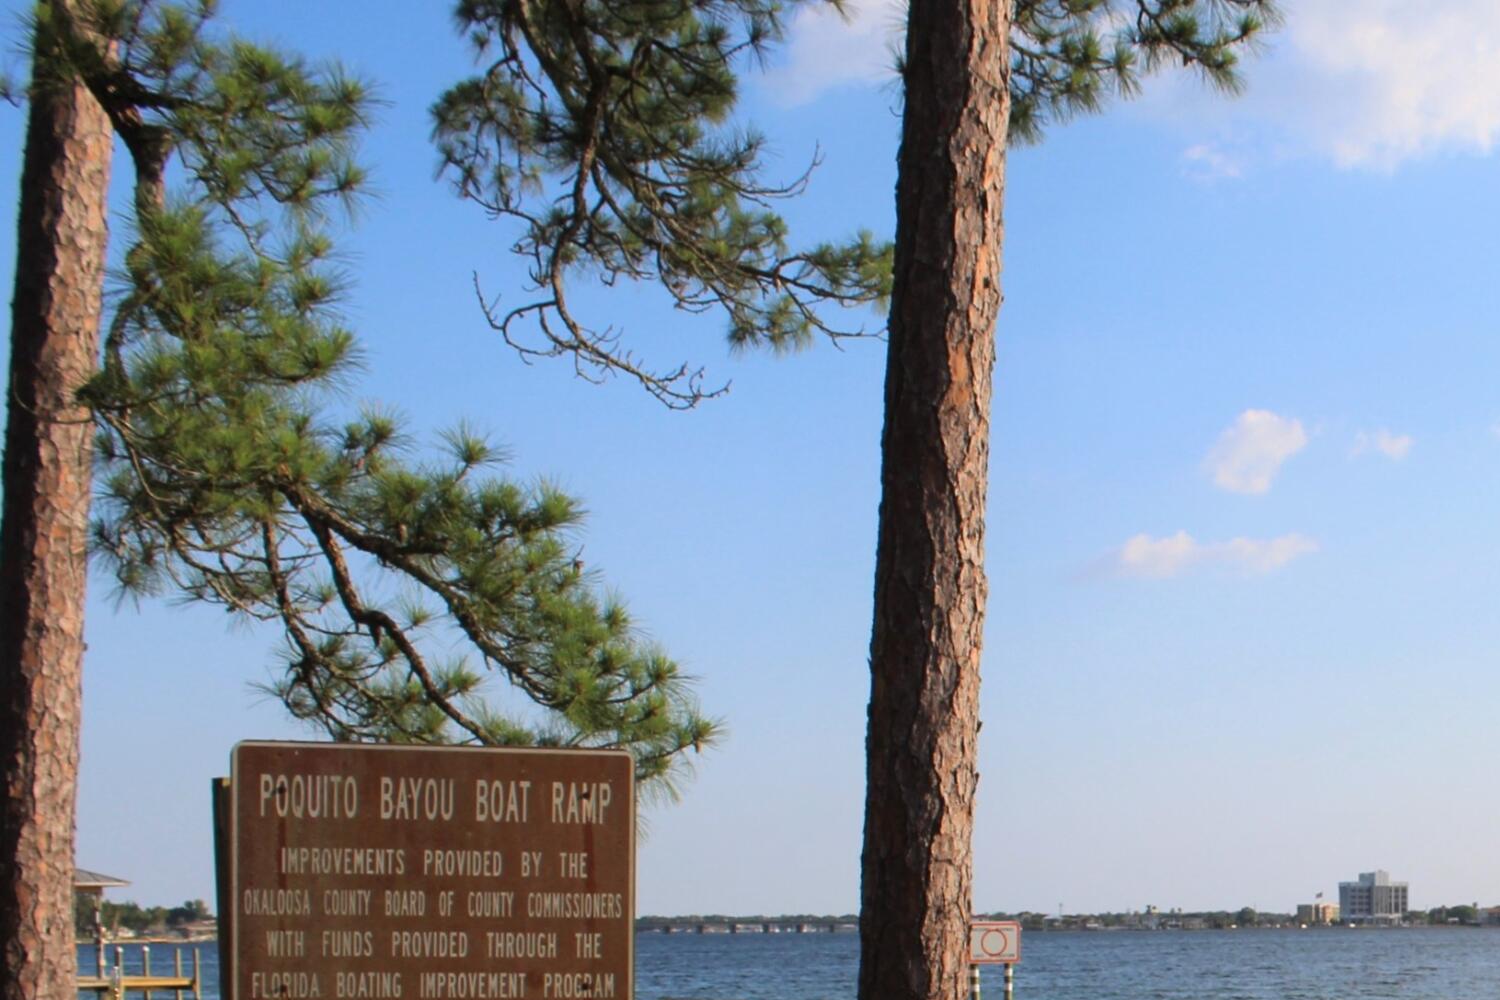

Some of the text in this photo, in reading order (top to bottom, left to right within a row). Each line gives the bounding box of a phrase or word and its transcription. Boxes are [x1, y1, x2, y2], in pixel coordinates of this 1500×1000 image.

[260, 774, 611, 824] POQUITO BAYOU BOAT RAMP
[281, 847, 588, 878] IMPROVEMENTS PROVIDED BY THE
[244, 889, 622, 918] OKALOOSA COUNTY BOARD OF COUNTY COMMISSIONERS
[266, 931, 601, 958] WITH FUNDS PROVIDED THROUGH THE
[252, 972, 615, 998] FLORIDA BOATING IMPROVEMENT PROGRAM
